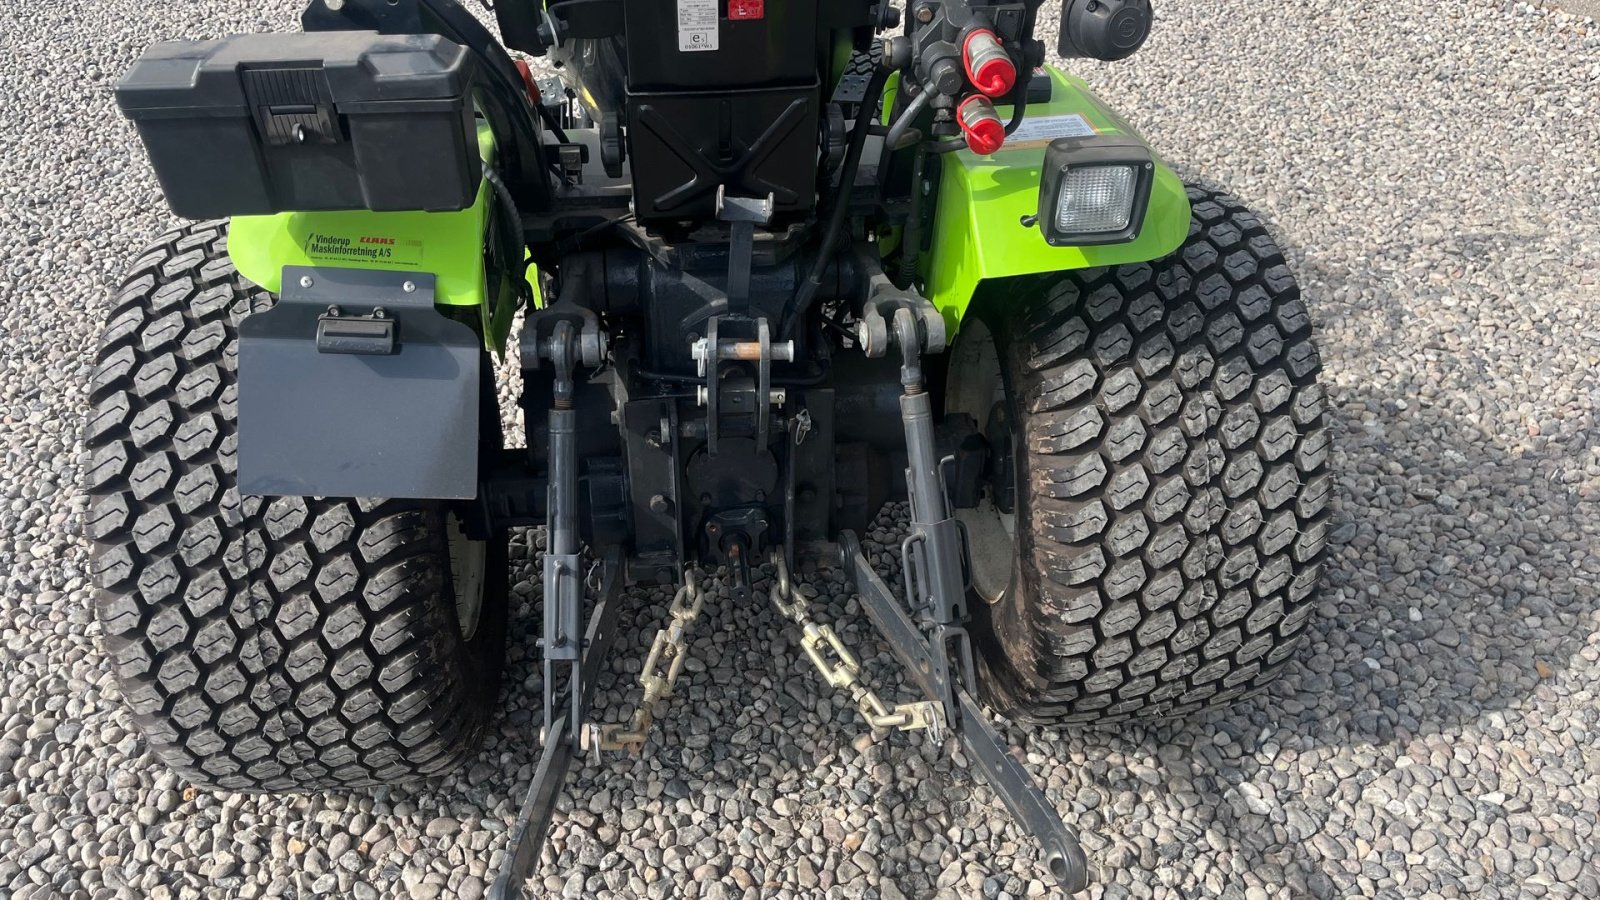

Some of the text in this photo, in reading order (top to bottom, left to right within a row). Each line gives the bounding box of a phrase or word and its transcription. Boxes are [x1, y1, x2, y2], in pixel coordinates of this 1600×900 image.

[316, 235, 351, 247] Vinderup
[359, 236, 396, 245] CLAAS
[311, 243, 392, 259] Maskinforretning A/S
